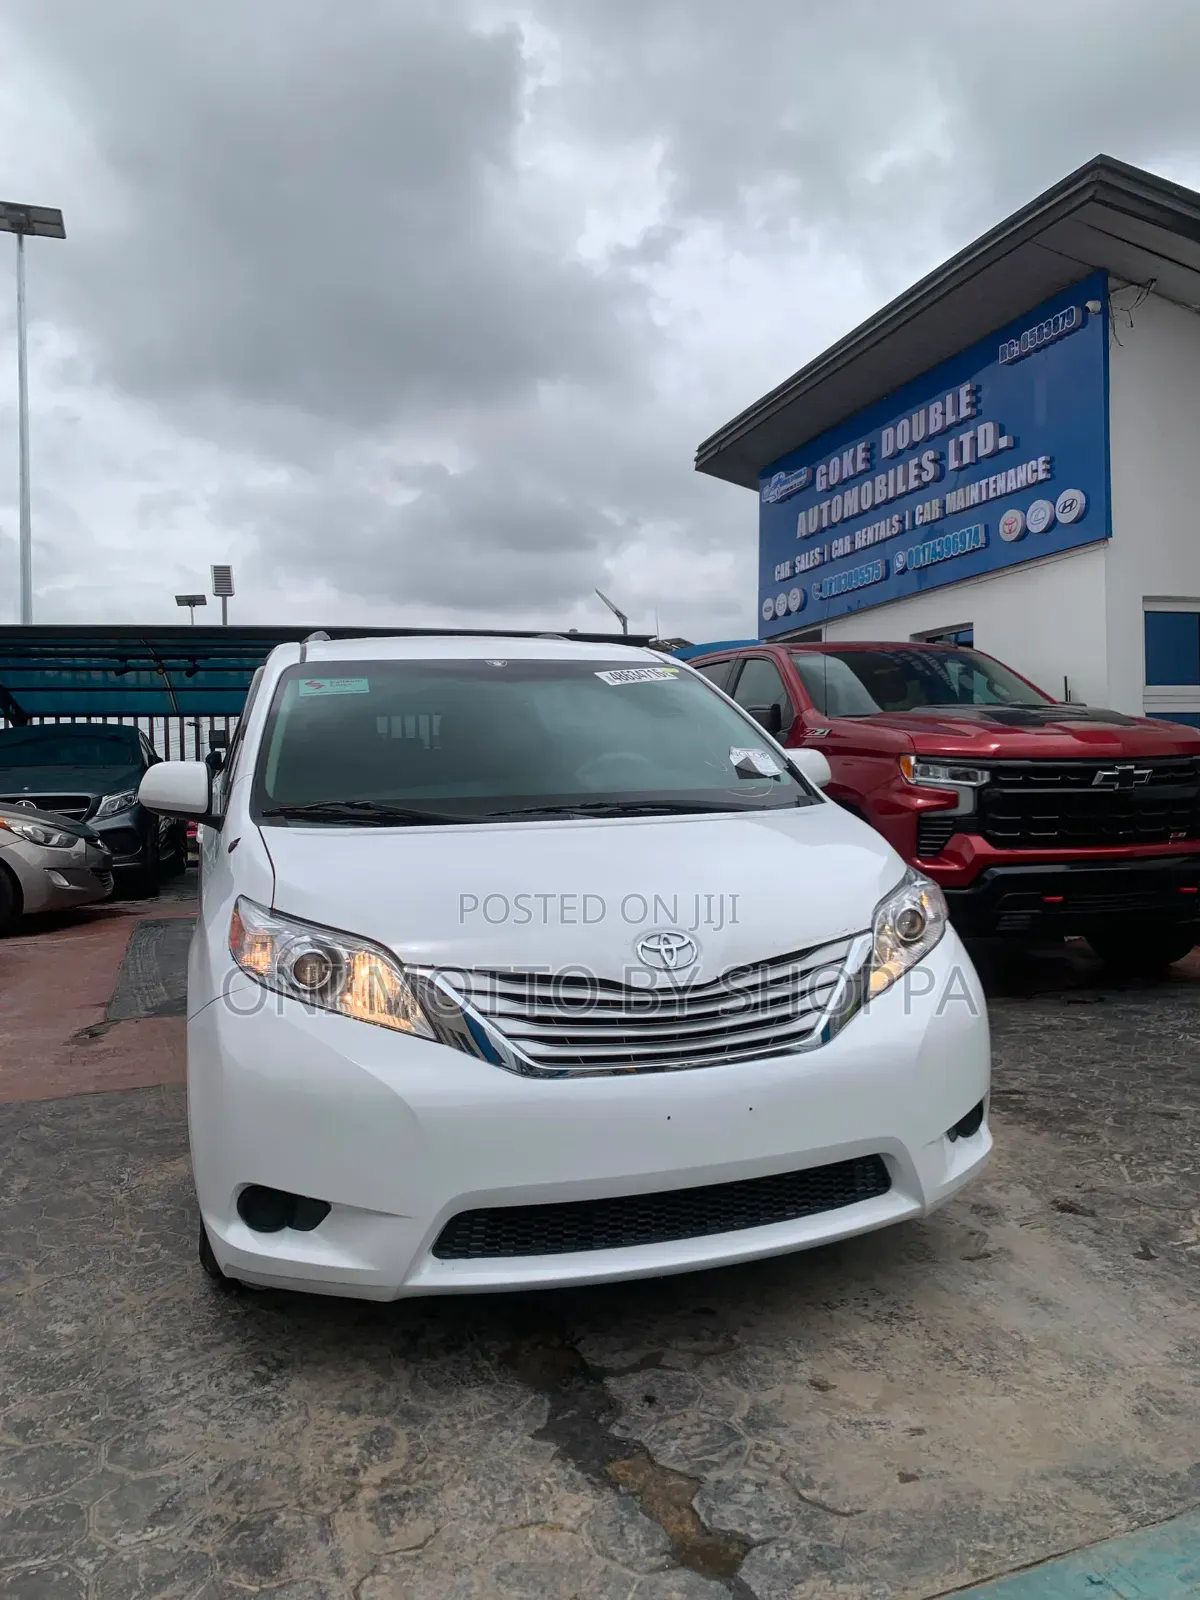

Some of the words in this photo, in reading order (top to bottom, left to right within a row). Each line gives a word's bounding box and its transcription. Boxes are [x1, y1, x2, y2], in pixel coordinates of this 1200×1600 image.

[999, 339, 1020, 364] RC:
[796, 450, 937, 539] AUTOMOBILES
[948, 421, 1009, 471] LTD.
[816, 441, 867, 492] GOKE
[881, 383, 973, 459] DOUBLE
[774, 560, 791, 582] CAR
[795, 547, 821, 574] SALES
[832, 535, 852, 558] CAR
[854, 514, 900, 550] RENTALS
[915, 498, 941, 526] CAR
[945, 455, 1048, 515] MAINTENANCE
